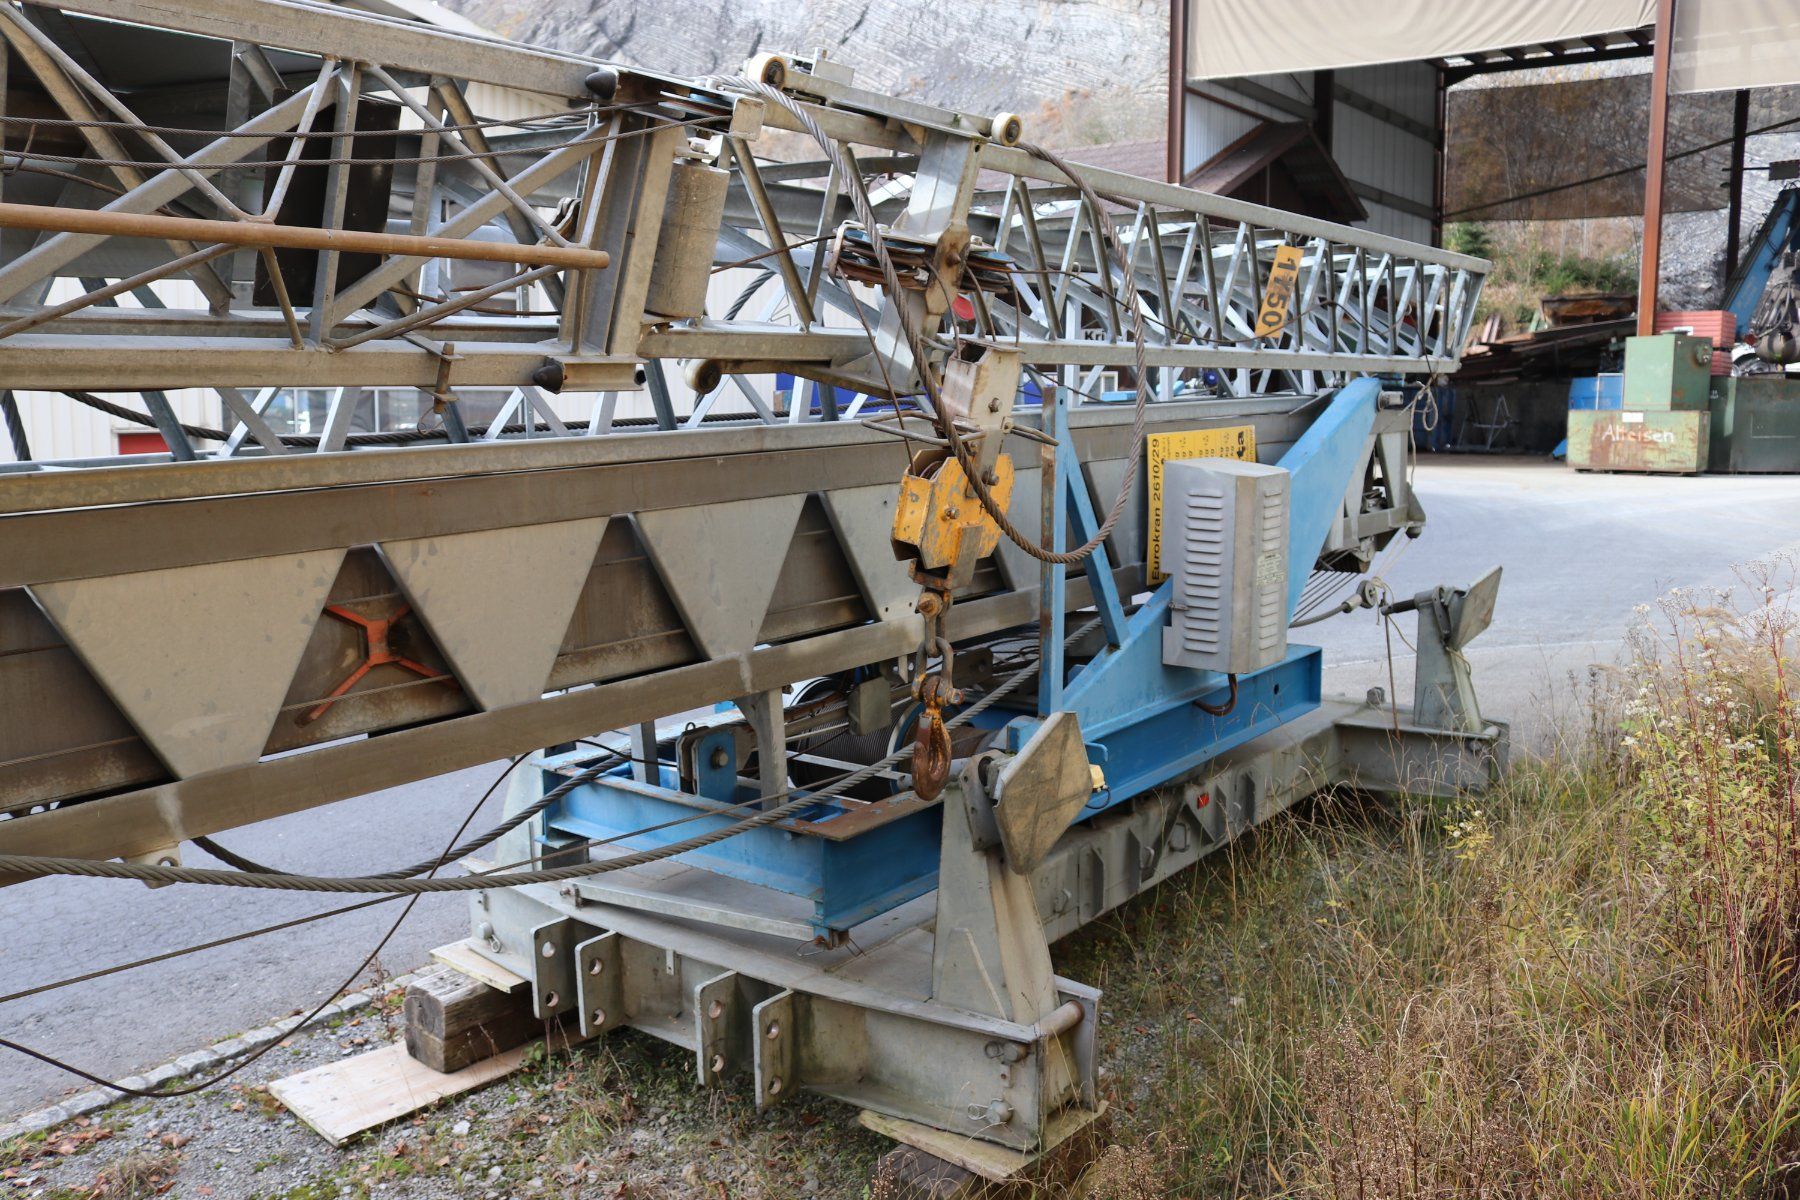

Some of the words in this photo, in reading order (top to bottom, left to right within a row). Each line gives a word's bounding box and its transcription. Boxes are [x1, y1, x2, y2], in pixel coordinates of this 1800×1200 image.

[1602, 423, 1674, 443] Alteisen
[1152, 438, 1161, 502] 2610/29
[1152, 508, 1161, 580] Eurokran
